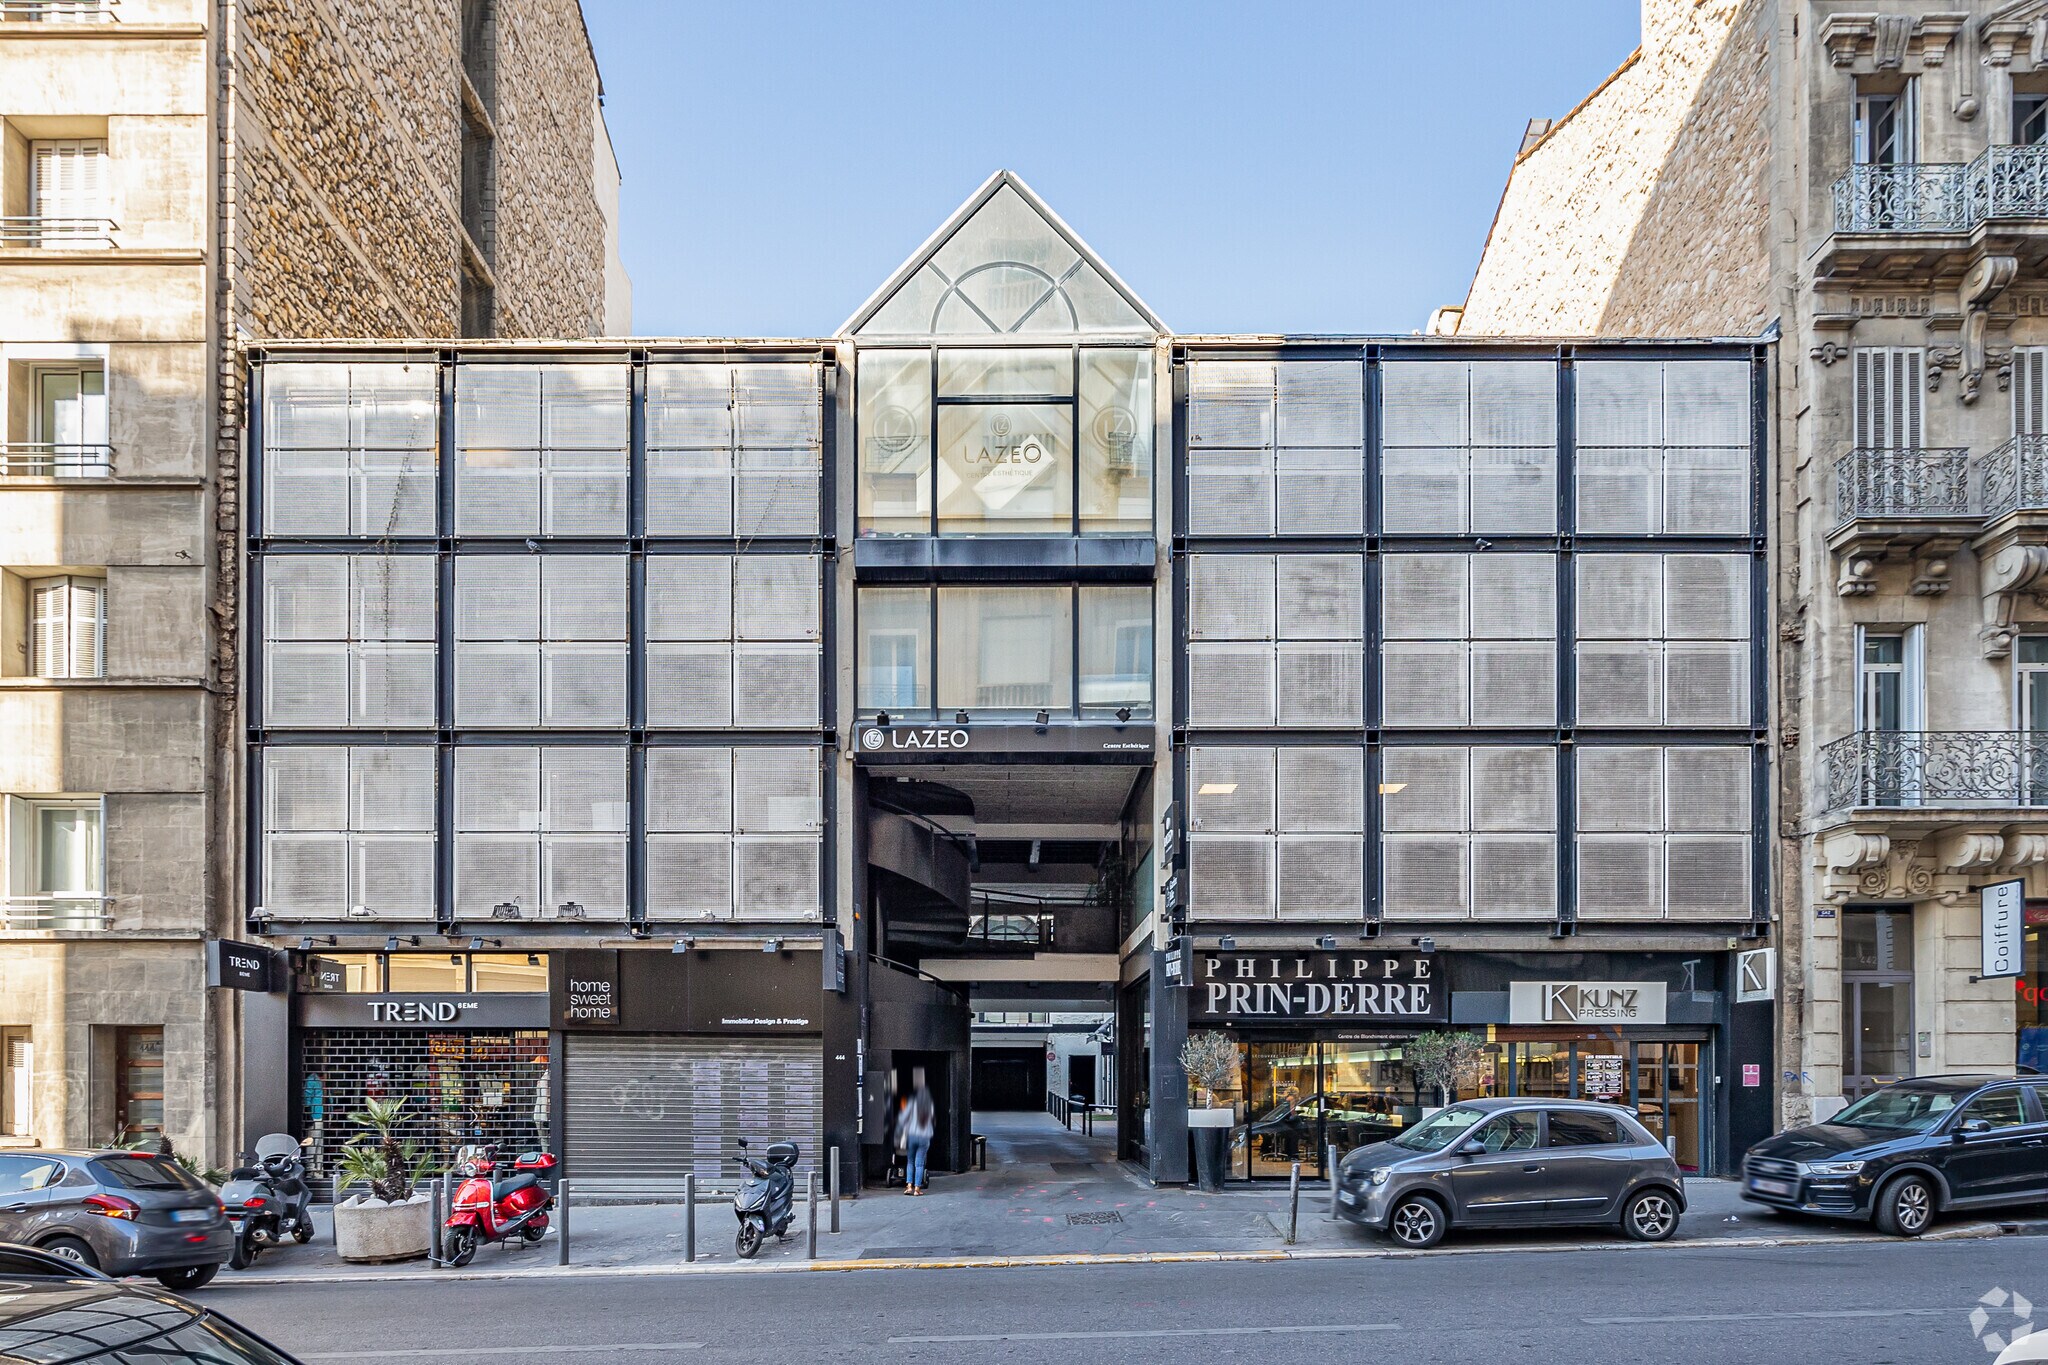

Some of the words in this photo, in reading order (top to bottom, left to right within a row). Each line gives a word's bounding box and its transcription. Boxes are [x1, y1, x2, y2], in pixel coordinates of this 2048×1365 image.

[963, 443, 1042, 464] LAZEO
[892, 729, 969, 749] LAZEO
[1994, 885, 2009, 973] Coiffure
[228, 955, 260, 970] TREND
[1204, 958, 1432, 979] PHILIPPE
[570, 978, 611, 992] home
[570, 992, 612, 1005] sweet
[1204, 982, 1432, 1015] PRIN-DERRE
[1580, 989, 1638, 1009] KUNZ
[366, 1002, 456, 1021] TREND
[570, 1004, 611, 1018] home
[1579, 1008, 1638, 1018] PRESSING
